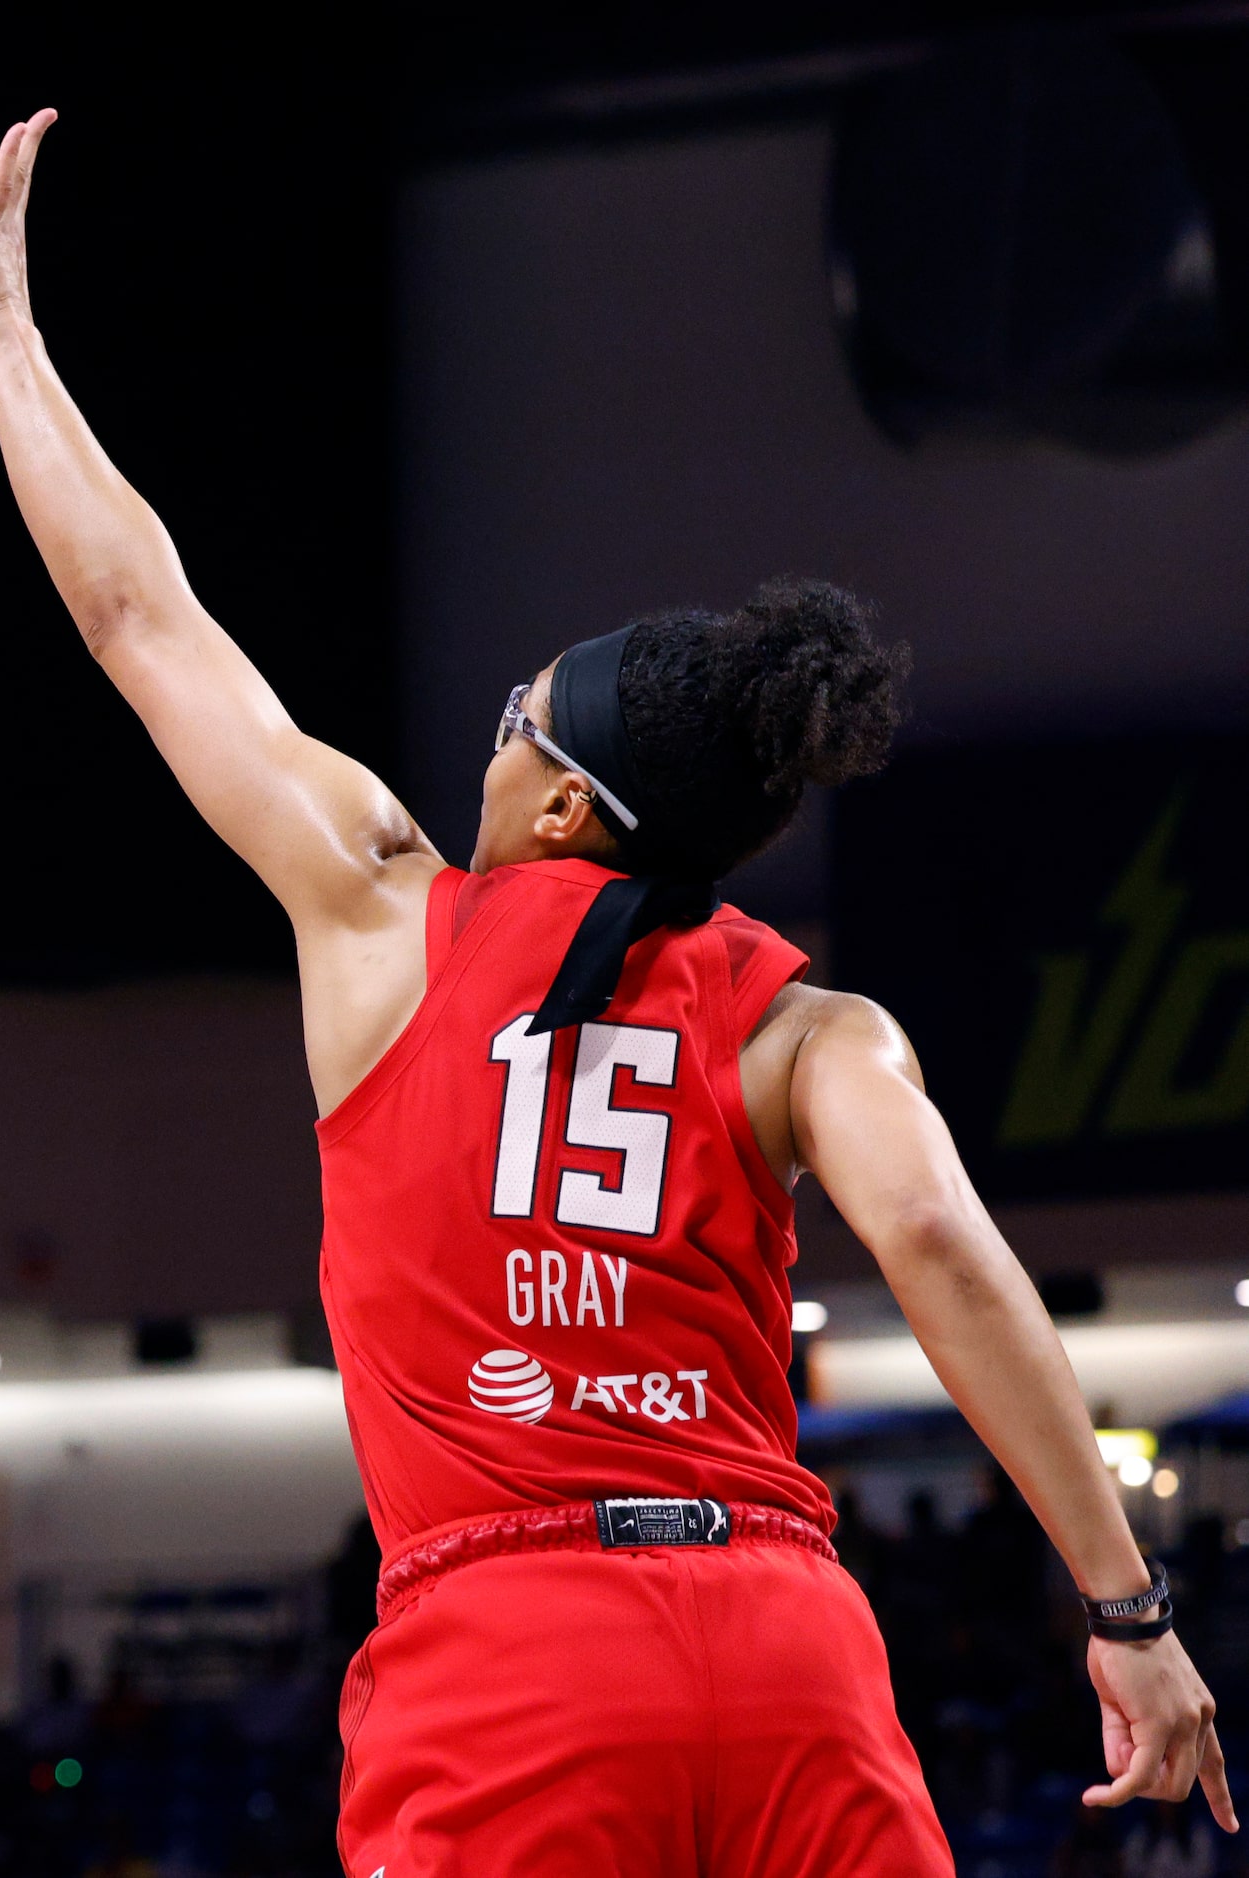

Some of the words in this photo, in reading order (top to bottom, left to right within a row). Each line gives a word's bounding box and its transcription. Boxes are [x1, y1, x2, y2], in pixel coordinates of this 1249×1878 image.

[487, 1012, 681, 1238] 15
[506, 1248, 628, 1328] GRAY
[570, 1369, 709, 1424] AT&T
